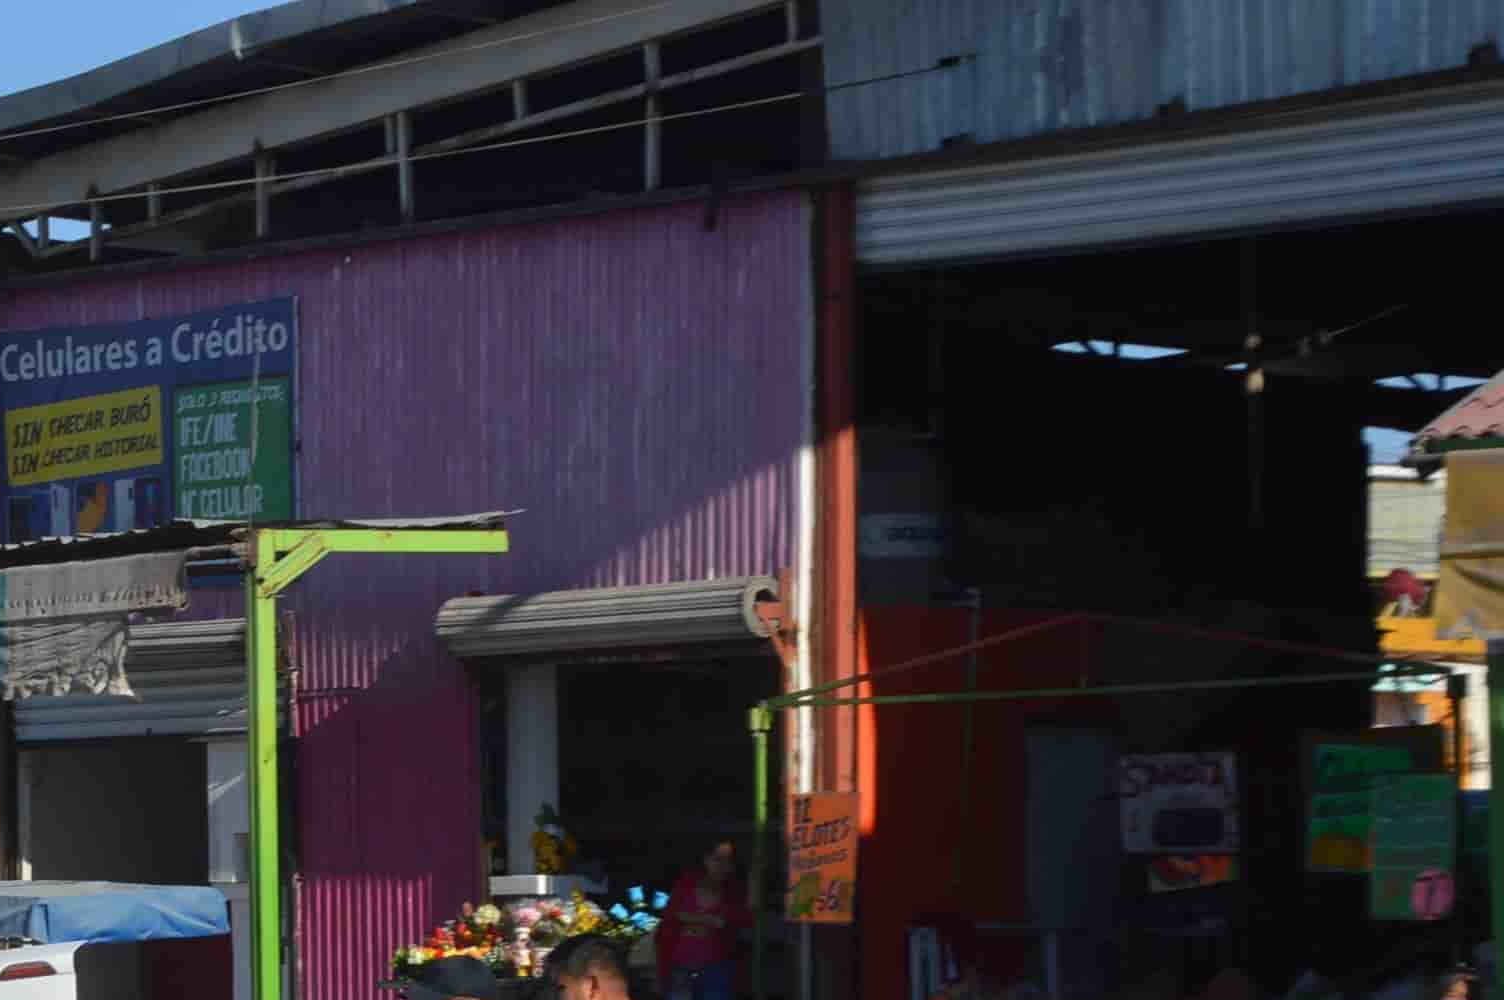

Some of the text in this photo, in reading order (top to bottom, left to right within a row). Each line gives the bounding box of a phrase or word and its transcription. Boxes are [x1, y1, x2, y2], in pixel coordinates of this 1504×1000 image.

[0, 314, 288, 382] Celulares a Crédito
[13, 394, 151, 448] SIN CHECAR BURÓ
[12, 453, 39, 477] SIN
[42, 444, 91, 467] CHECAR
